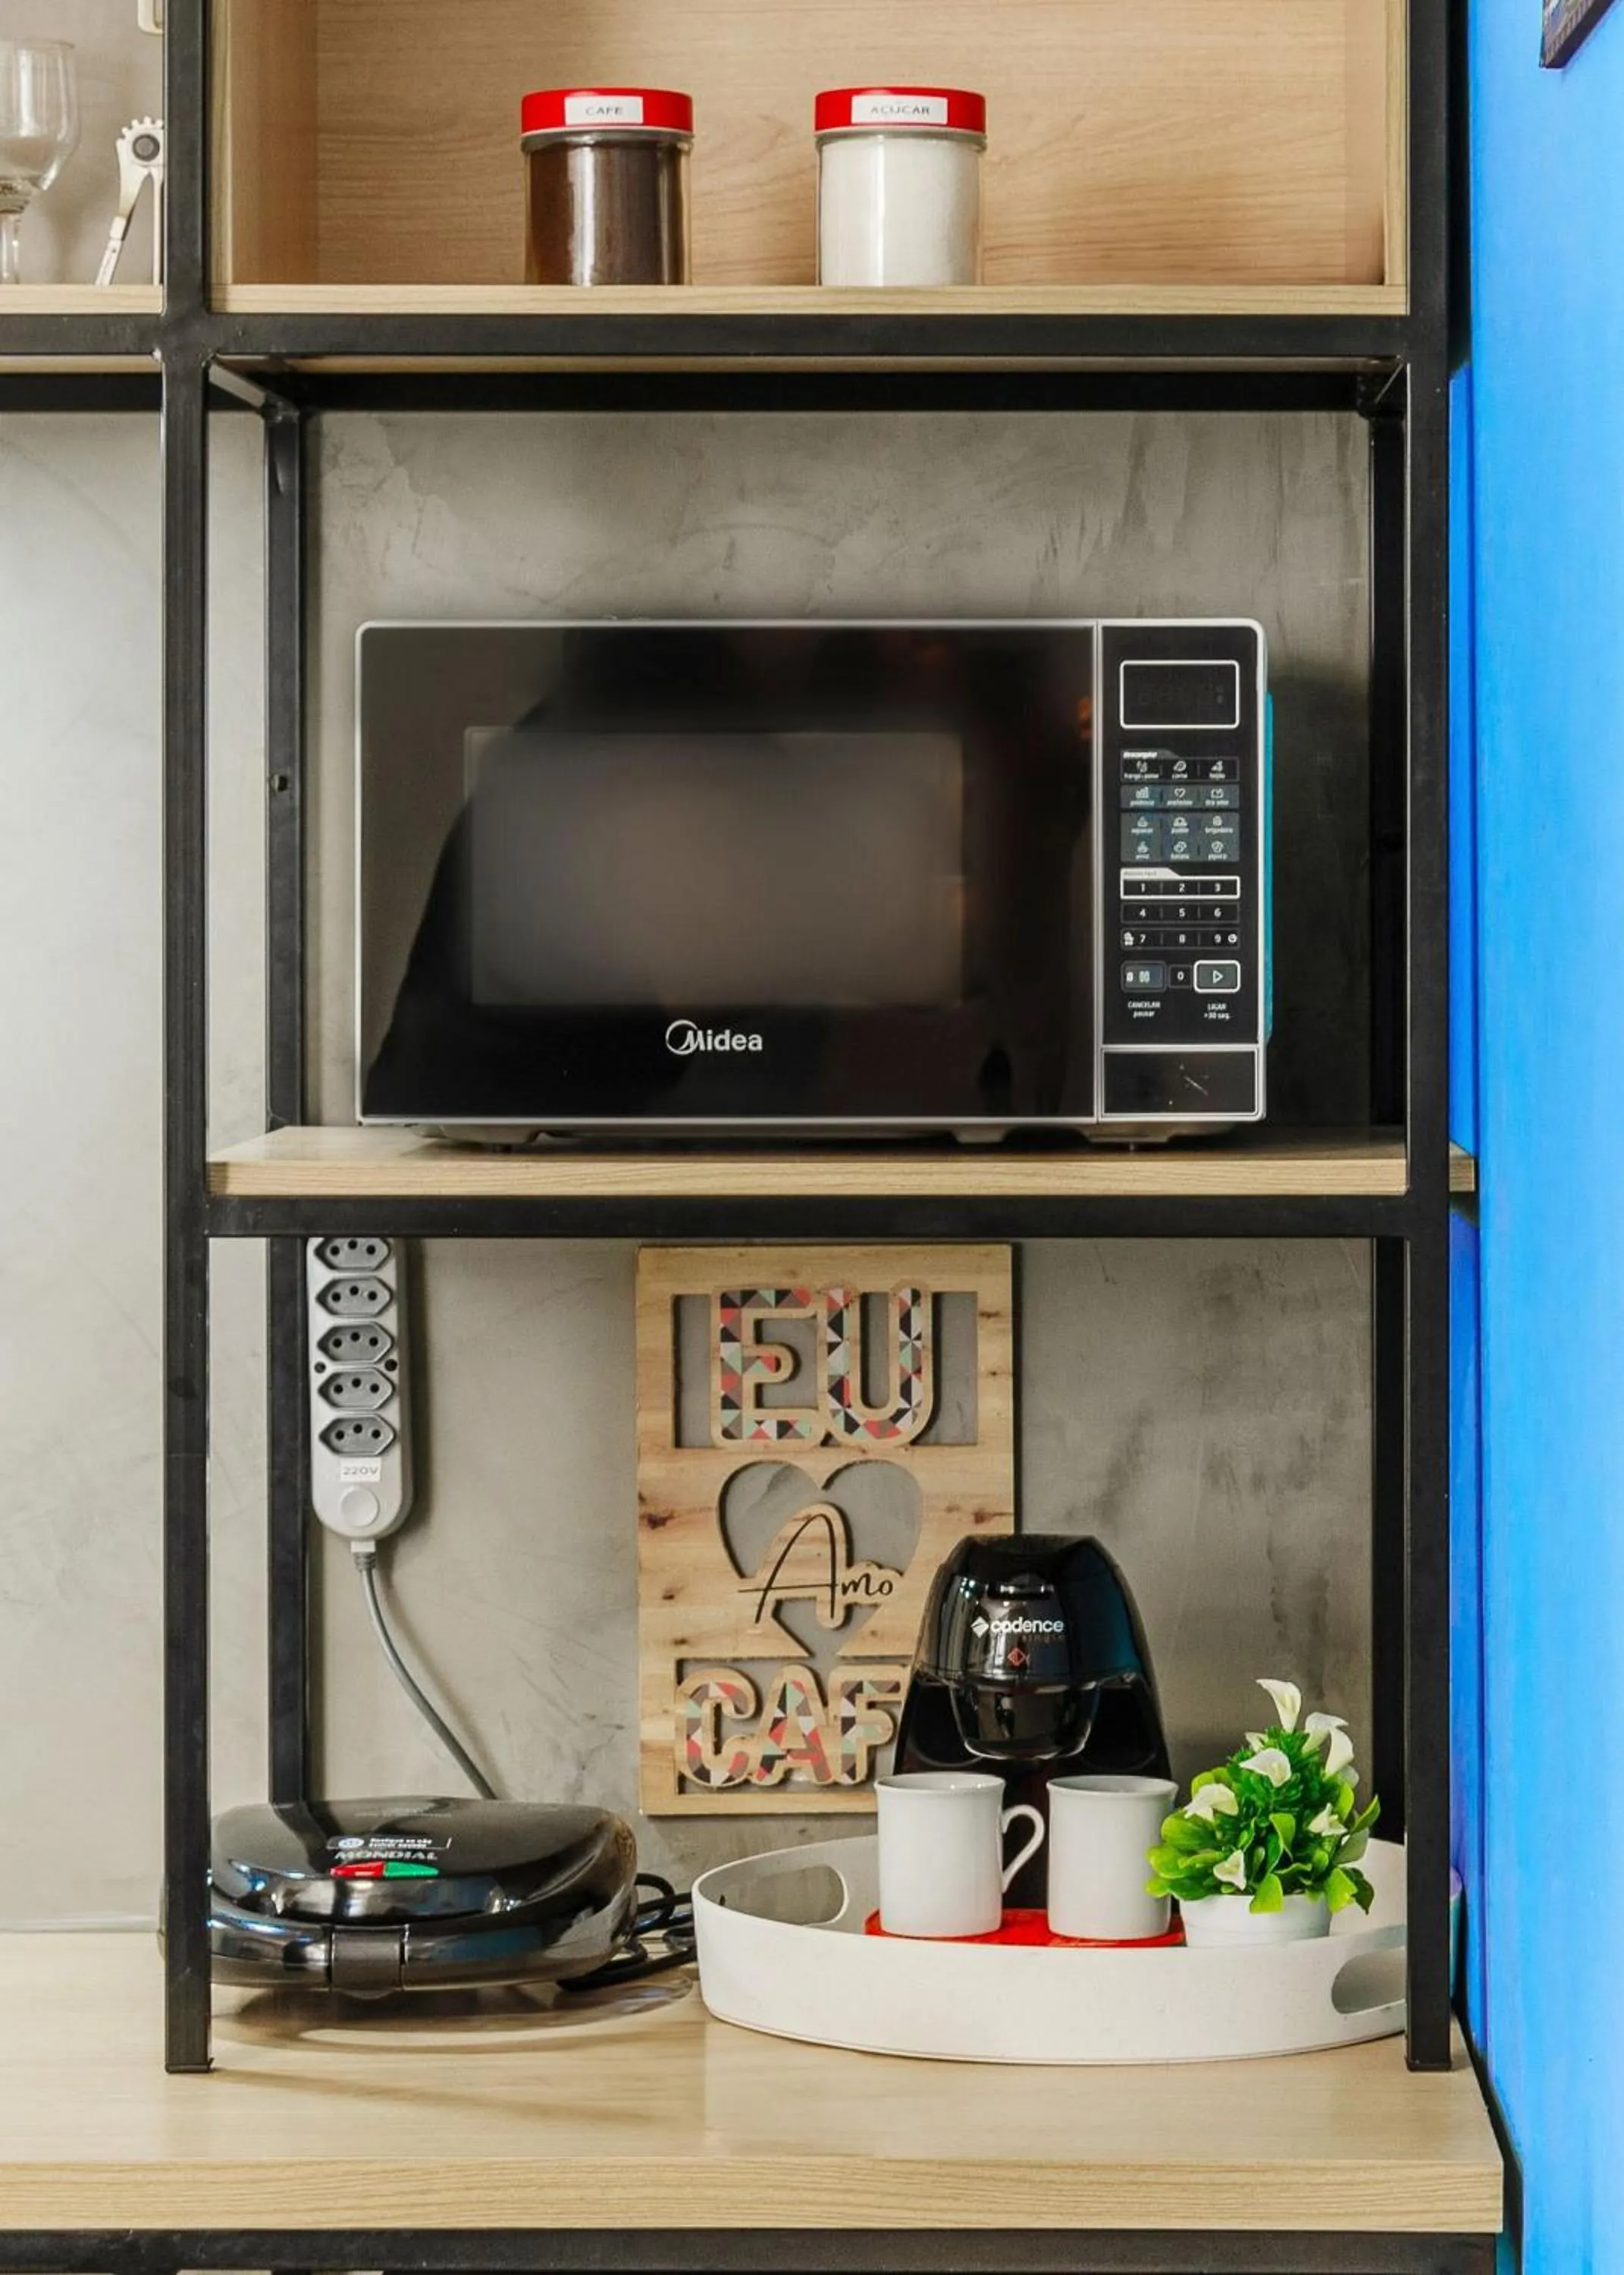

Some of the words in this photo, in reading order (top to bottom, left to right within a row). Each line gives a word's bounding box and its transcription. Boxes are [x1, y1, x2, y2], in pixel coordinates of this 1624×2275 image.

[1140, 883, 1146, 893] 1
[1178, 883, 1186, 893] 2
[1214, 883, 1221, 893] 3
[1139, 908, 1146, 918] 4
[1178, 907, 1186, 918] 5
[1214, 907, 1221, 918] 6
[1140, 934, 1146, 943] 7
[1214, 934, 1221, 943] 9
[1177, 971, 1184, 981] 0
[665, 1019, 763, 1055] Midea
[715, 1286, 928, 1442] EU
[738, 1512, 895, 1625] Amo
[990, 1617, 1064, 1633] cadence
[679, 1671, 904, 1785] CAF
[334, 1850, 437, 1860] MONDIAL
